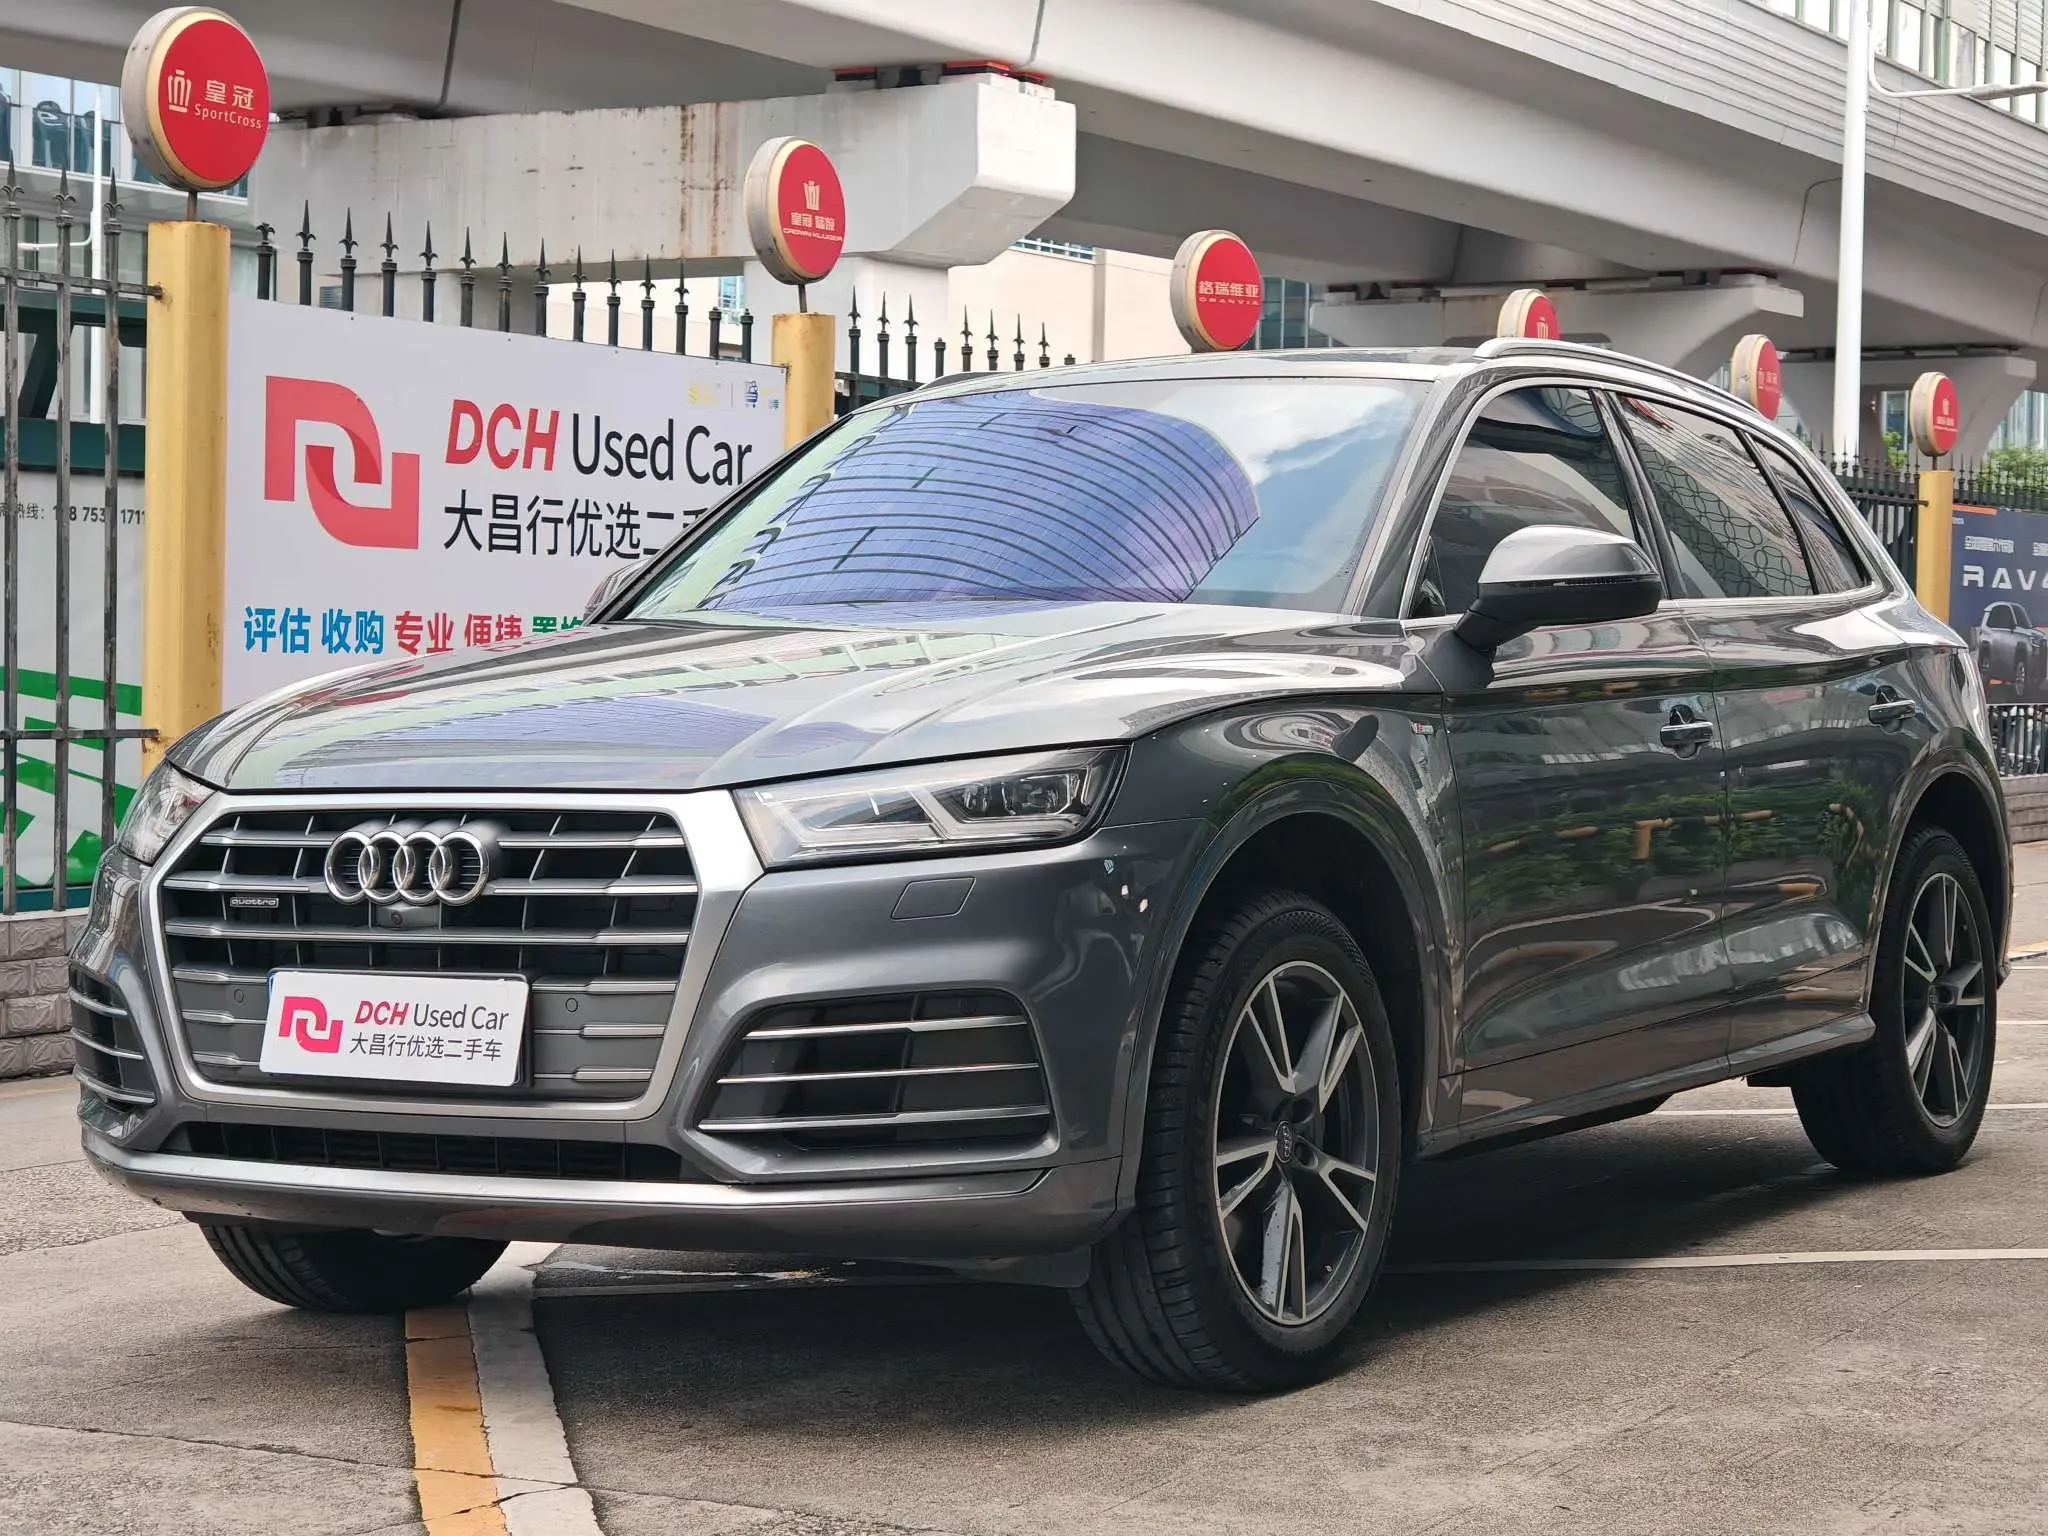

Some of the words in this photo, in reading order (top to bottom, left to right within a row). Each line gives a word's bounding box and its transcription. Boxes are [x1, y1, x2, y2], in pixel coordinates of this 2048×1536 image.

[204, 79, 255, 111] 皇冠
[194, 103, 262, 129] SportCross
[1198, 280, 1259, 298] 格瑞维亚
[445, 398, 560, 472] DCH
[572, 412, 675, 480] Used
[685, 424, 753, 487] Car
[1962, 564, 2048, 591] RAV
[244, 605, 312, 654] 评估
[320, 607, 385, 655] 收购
[394, 610, 455, 656] 专业
[230, 898, 277, 906] quattro
[354, 1000, 410, 1026] DCH
[412, 1003, 468, 1029] Used
[470, 1005, 510, 1031] Car
[349, 1031, 503, 1061] 大昌行优选二手车
